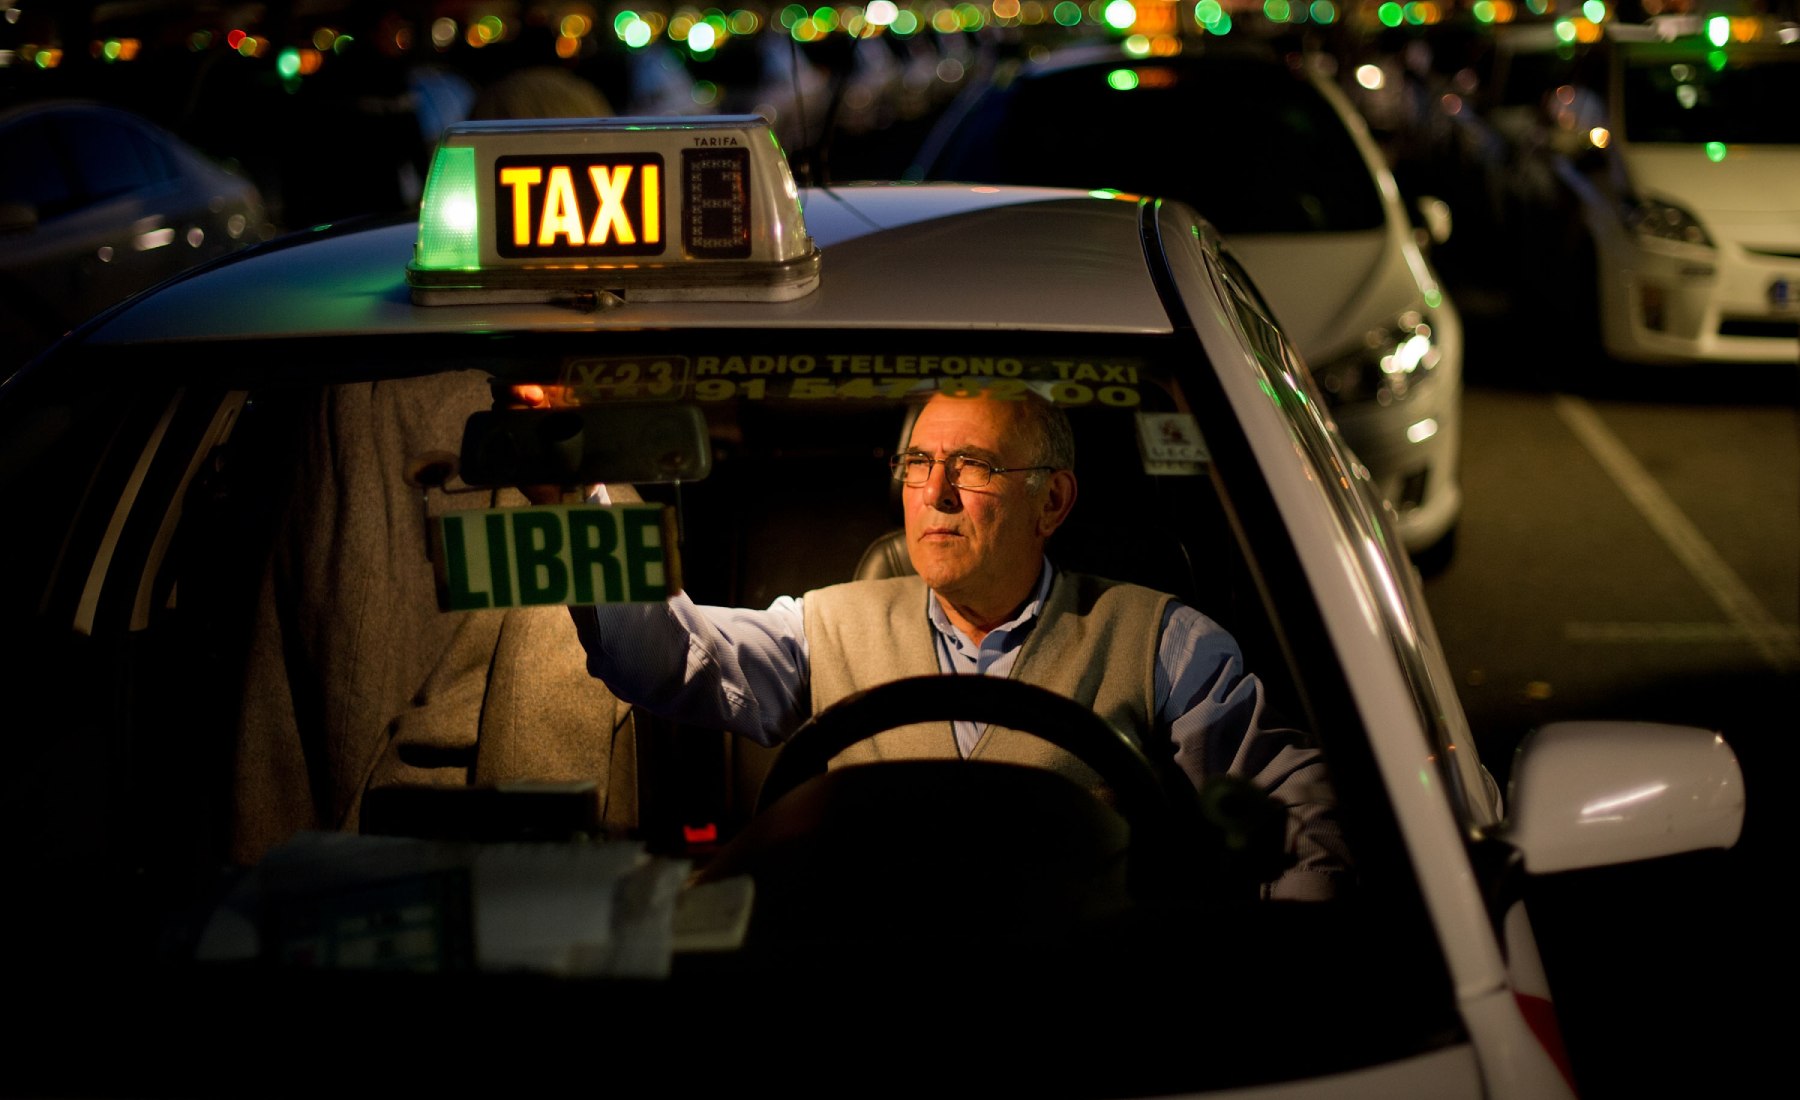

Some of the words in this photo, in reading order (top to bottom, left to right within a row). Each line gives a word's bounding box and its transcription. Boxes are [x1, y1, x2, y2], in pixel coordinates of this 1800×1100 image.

[694, 136, 739, 147] TARIFA
[499, 163, 660, 247] TAXI
[696, 355, 817, 376] RADIO
[827, 355, 1024, 377] TELEFONO
[1051, 359, 1139, 384] TAXI
[696, 377, 767, 401] 91
[787, 377, 920, 400] 547
[1050, 381, 1140, 407] 00
[443, 508, 669, 610] LIBRE
